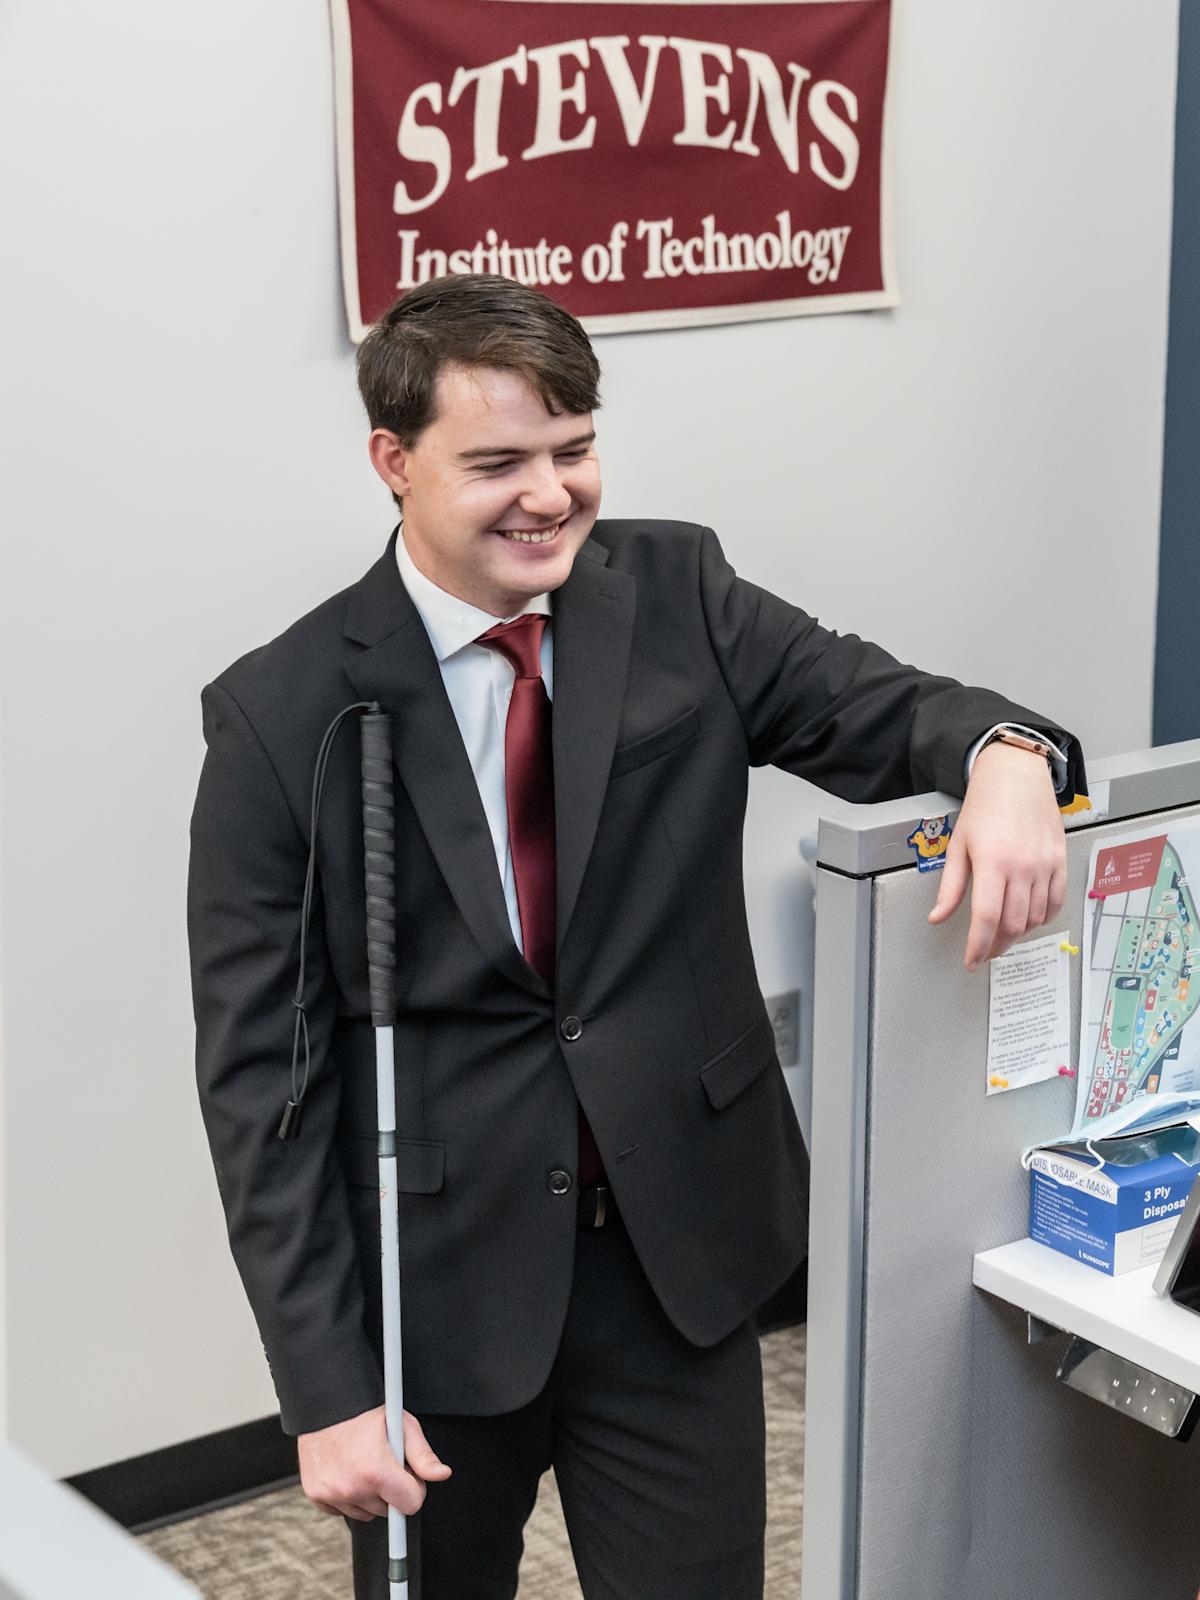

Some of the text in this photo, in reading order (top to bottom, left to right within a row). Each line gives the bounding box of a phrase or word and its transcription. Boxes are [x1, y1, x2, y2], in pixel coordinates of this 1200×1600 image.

[393, 35, 860, 214] STEVENS
[396, 210, 851, 289] Institute of Technology
[1086, 1178, 1112, 1199] MASK
[1144, 1186, 1171, 1202] 3 Ply
